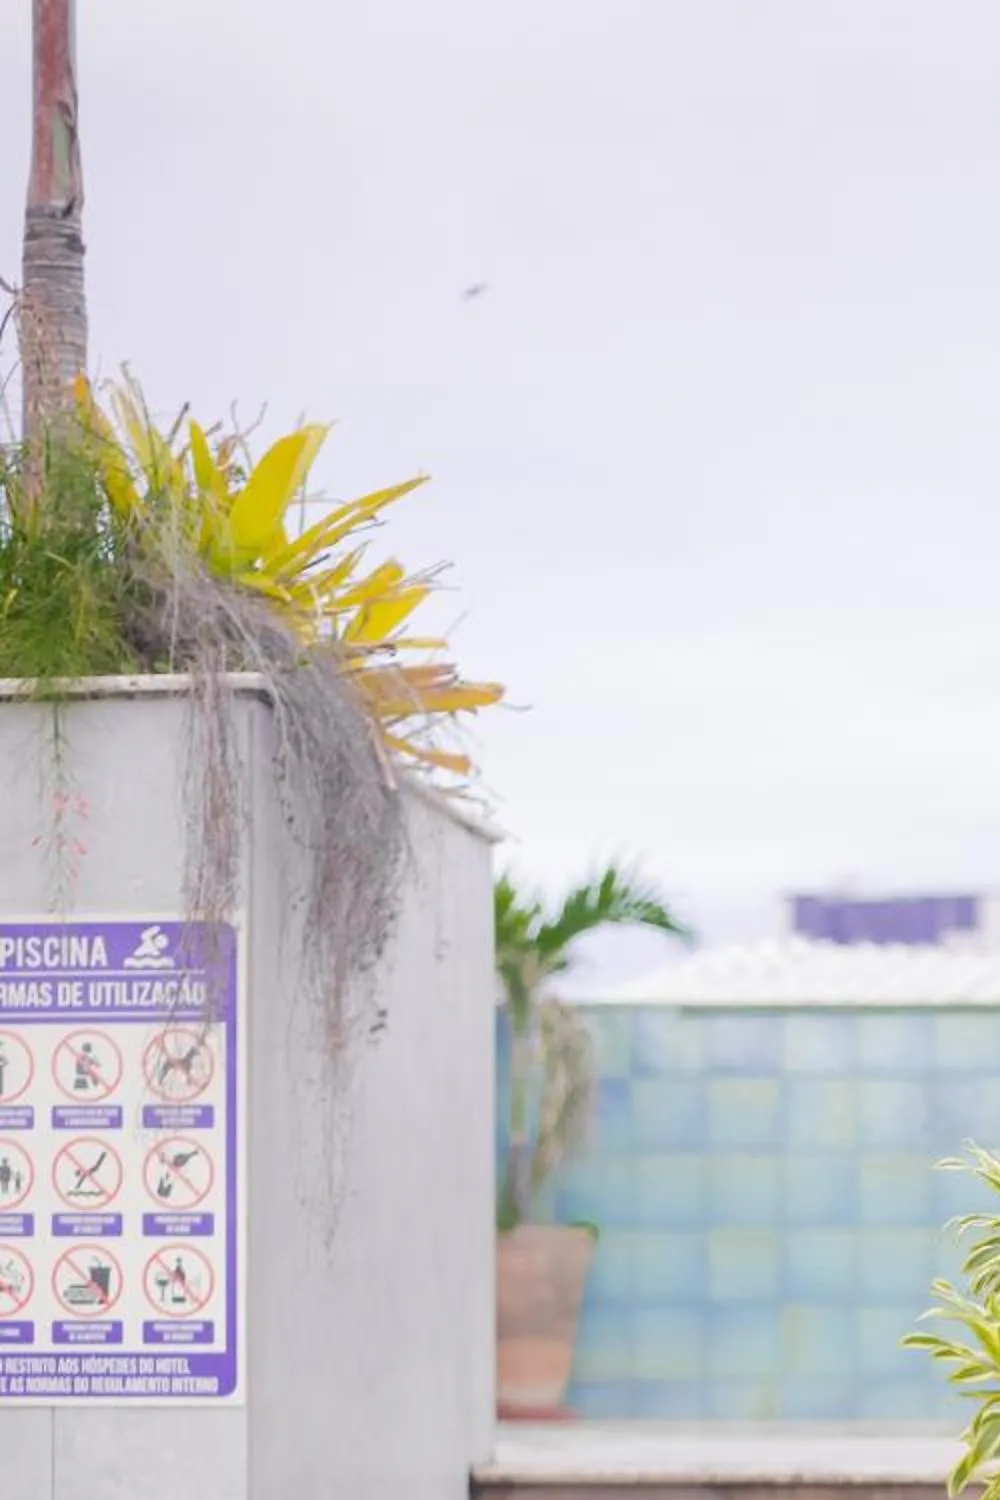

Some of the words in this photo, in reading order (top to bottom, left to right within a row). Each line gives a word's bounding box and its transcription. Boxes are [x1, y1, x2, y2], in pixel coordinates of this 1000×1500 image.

[0, 935, 108, 968] PISCINA
[57, 981, 83, 1007] DE
[89, 976, 206, 1009] UTILIZAÇÃO
